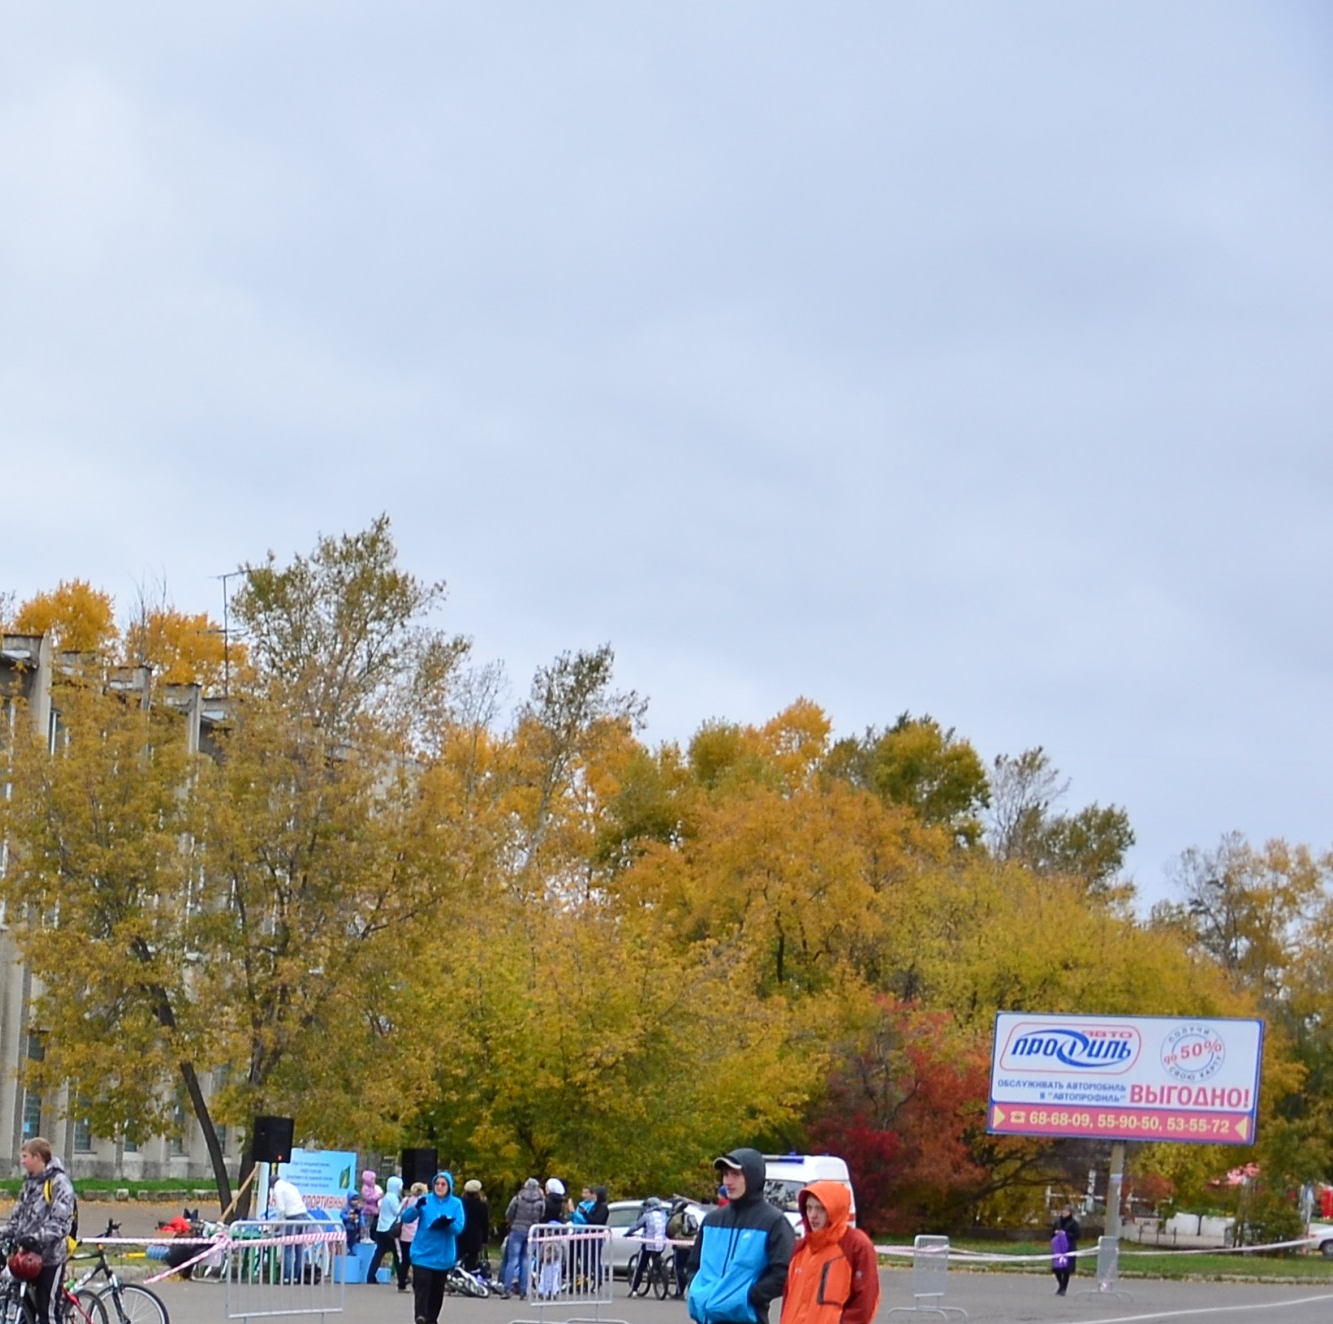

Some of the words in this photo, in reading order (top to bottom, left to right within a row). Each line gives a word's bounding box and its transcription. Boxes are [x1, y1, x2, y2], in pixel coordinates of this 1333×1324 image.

[1180, 1039, 1222, 1060] 50%
[997, 1079, 1064, 1089] ОБСЛУЖИВАТЬ
[1066, 1081, 1126, 1092] АВТОМОБИЛЬ
[1130, 1084, 1250, 1108] ВЫГОДНО!
[1029, 1111, 1093, 1128] 68-68-09,
[1098, 1113, 1162, 1132] 55-90-50,
[1167, 1116, 1230, 1133] 53-55-72
